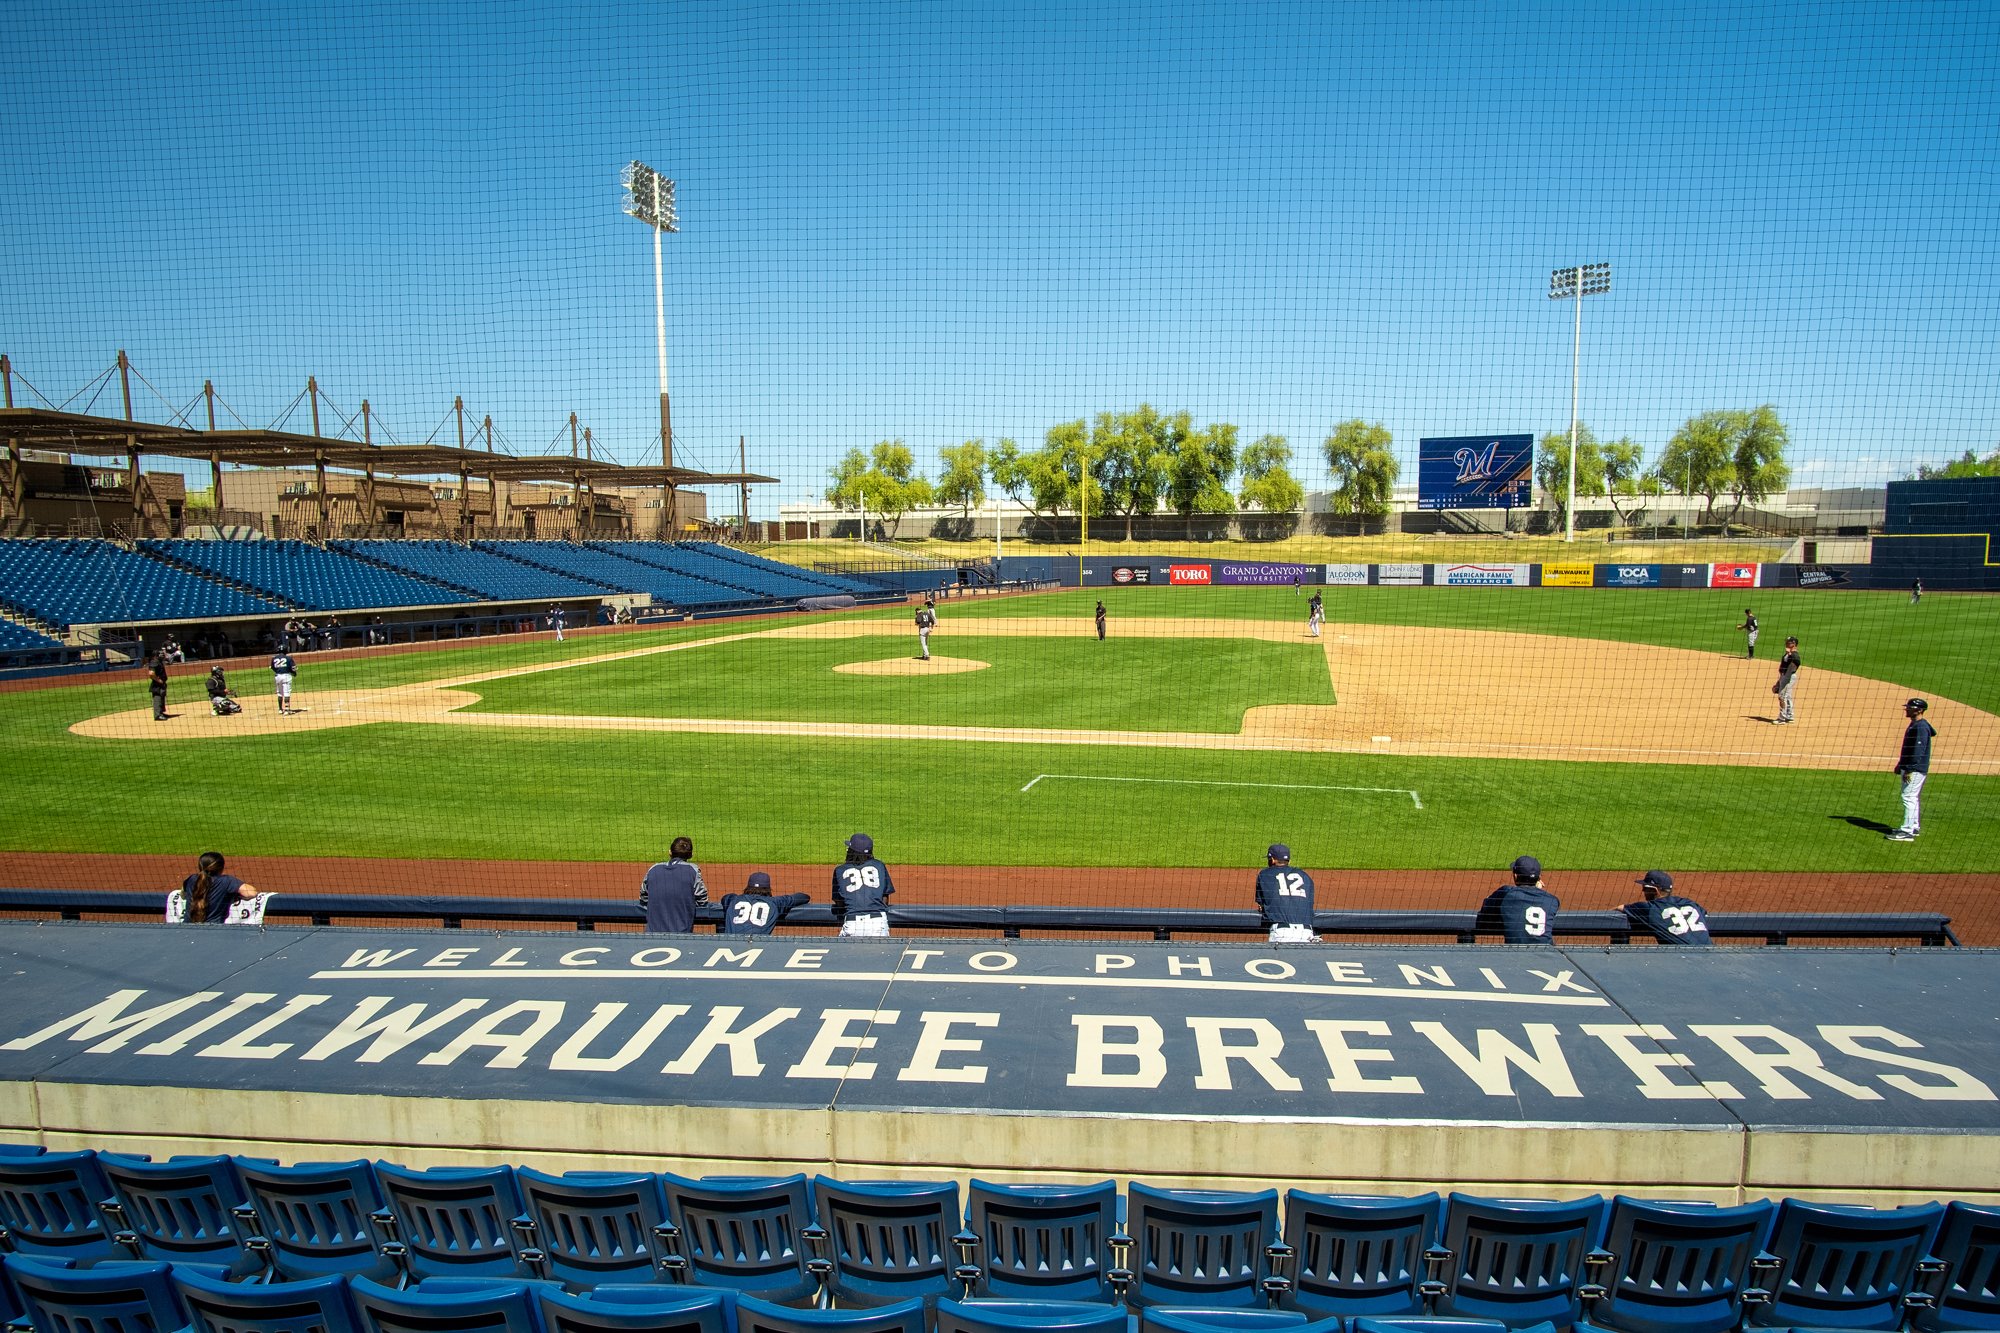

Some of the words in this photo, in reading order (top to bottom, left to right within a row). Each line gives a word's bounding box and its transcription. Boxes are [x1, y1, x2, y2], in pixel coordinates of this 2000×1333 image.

[1173, 569, 1206, 580] TORO
[1223, 566, 1259, 576] GRAND
[1260, 566, 1303, 576] CANYON
[1329, 571, 1365, 579] ALGODON
[1618, 568, 1649, 578] TOCA
[1800, 575, 1833, 585] CHAMPIONS
[274, 658, 287, 668] 22
[842, 866, 881, 893] 38
[1276, 872, 1307, 898] 12
[733, 901, 770, 928] 30
[1524, 906, 1547, 937] 9
[1661, 905, 1708, 936] 32
[341, 946, 829, 969] WELCOME
[905, 950, 1018, 972] TO
[1095, 954, 1596, 993] PHOENIX
[0, 988, 1001, 1084] MILWAUKEE
[1066, 1014, 1998, 1101] BREWERS
